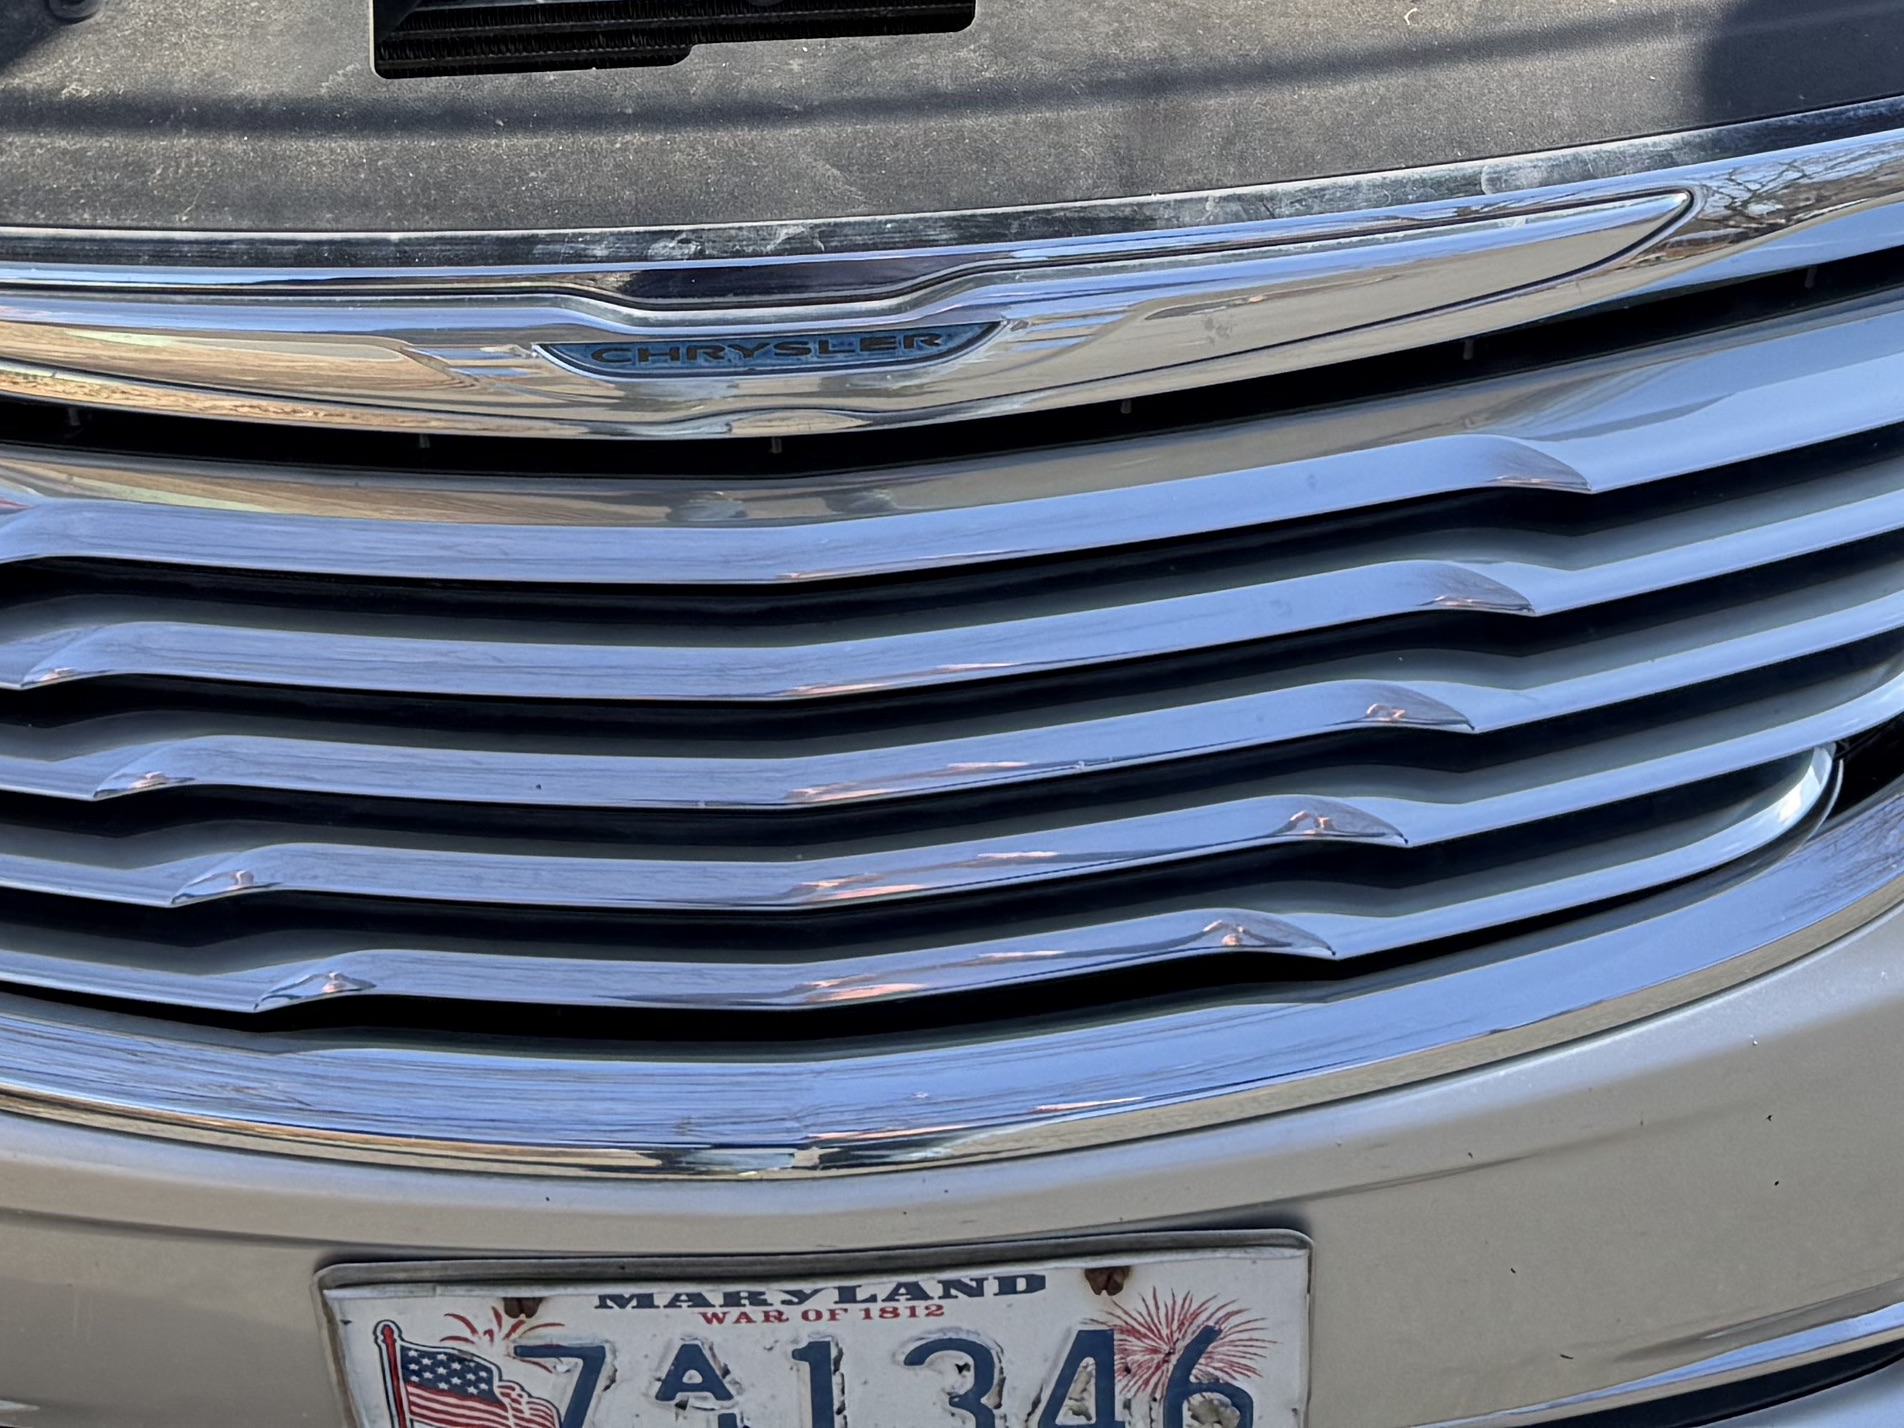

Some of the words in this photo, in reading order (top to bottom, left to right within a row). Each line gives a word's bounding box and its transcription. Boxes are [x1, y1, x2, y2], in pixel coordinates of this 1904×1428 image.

[590, 331, 948, 366] CHRYSLER
[594, 1273, 1047, 1311] MARYLAND
[700, 1309, 789, 1325] WAR
[800, 1307, 849, 1323] OF
[860, 1303, 945, 1321] 1812
